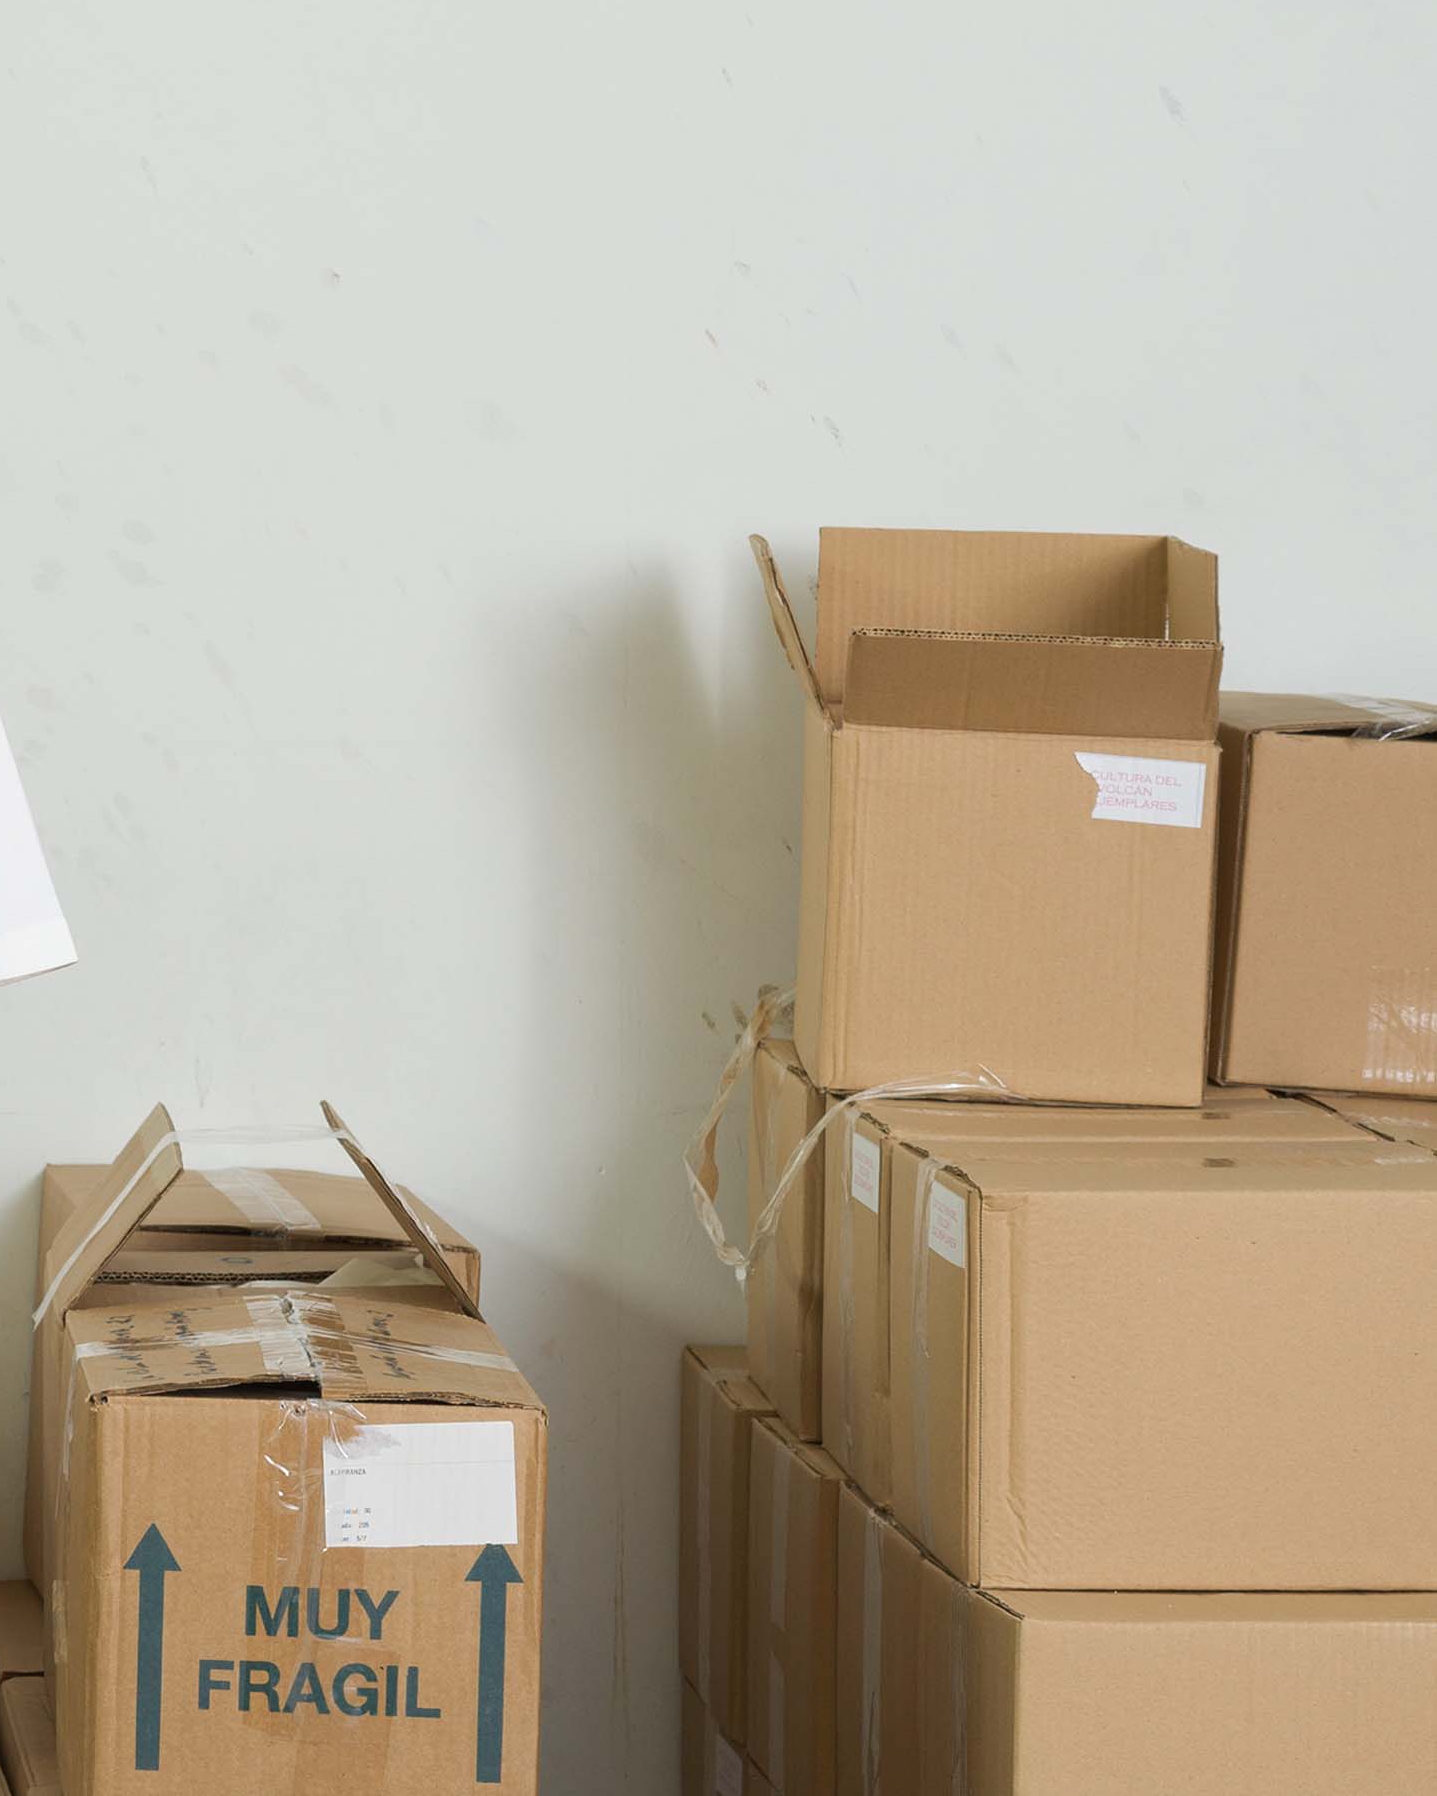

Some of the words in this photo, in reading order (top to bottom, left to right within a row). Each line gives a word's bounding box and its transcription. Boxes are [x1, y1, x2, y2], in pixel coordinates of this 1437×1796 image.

[1156, 775, 1182, 787] DEL
[244, 1585, 399, 1640] MUY
[197, 1659, 441, 1718] FRAGIL
